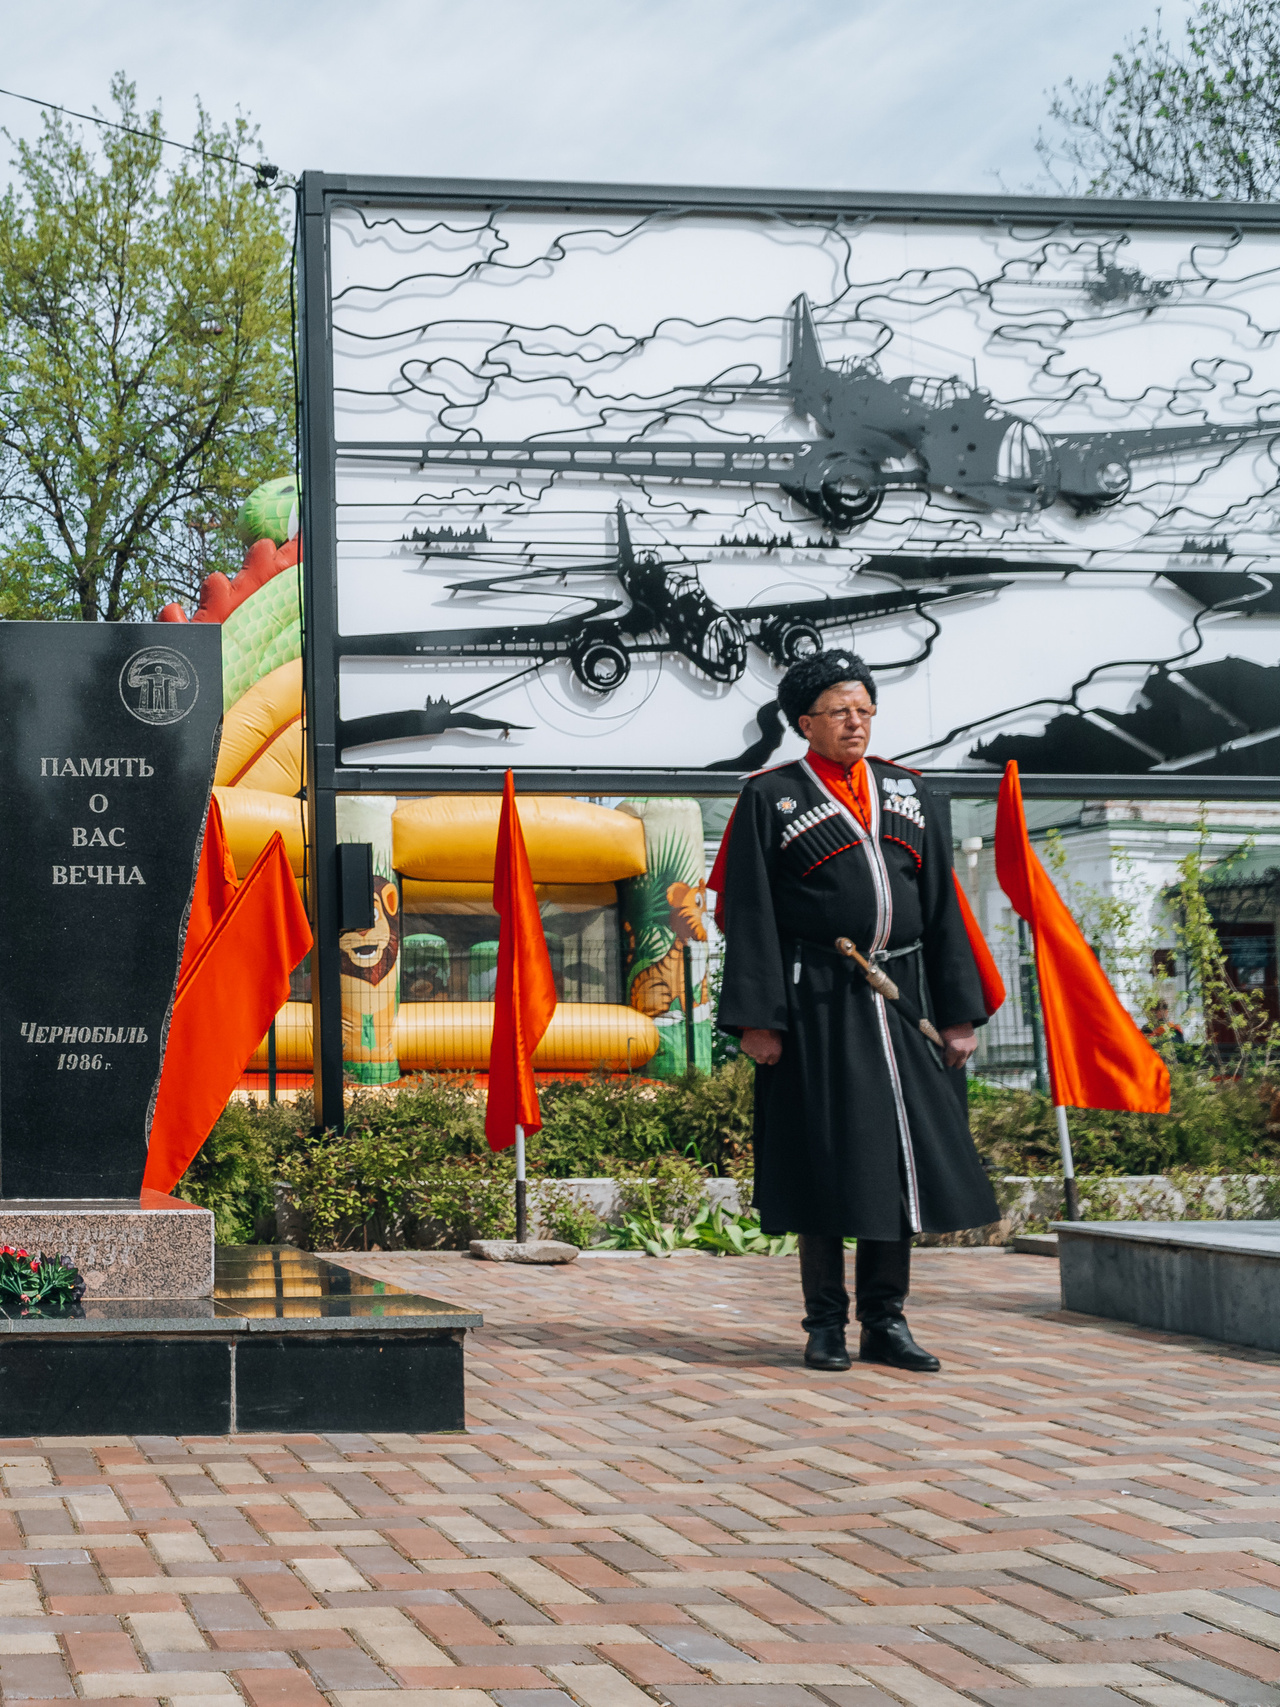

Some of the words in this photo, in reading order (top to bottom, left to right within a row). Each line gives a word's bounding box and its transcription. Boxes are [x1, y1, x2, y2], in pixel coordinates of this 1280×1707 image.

[40, 757, 155, 777] ПАМЯТЬ
[89, 793, 109, 814] О
[72, 827, 126, 847] ВАС
[52, 865, 147, 885] ВЕЧНА
[20, 1022, 149, 1043] ЧЕРНОБЫЛЬ
